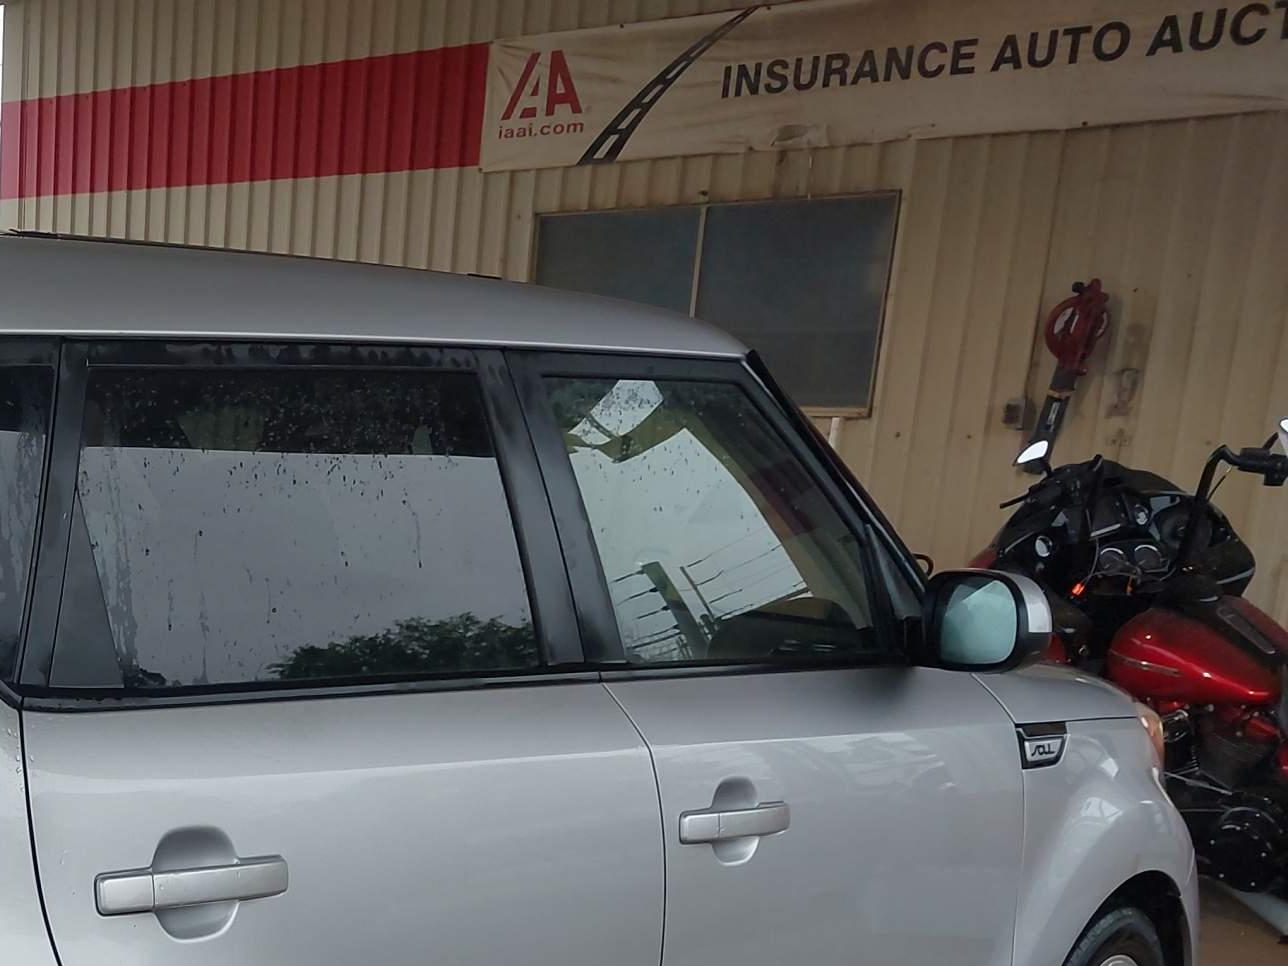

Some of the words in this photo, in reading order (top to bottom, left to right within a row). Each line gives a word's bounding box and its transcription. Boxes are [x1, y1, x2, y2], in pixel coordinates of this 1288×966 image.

[721, 38, 979, 98] INSURANCE
[990, 21, 1131, 72] AUTO
[498, 121, 584, 139] iaai.com
